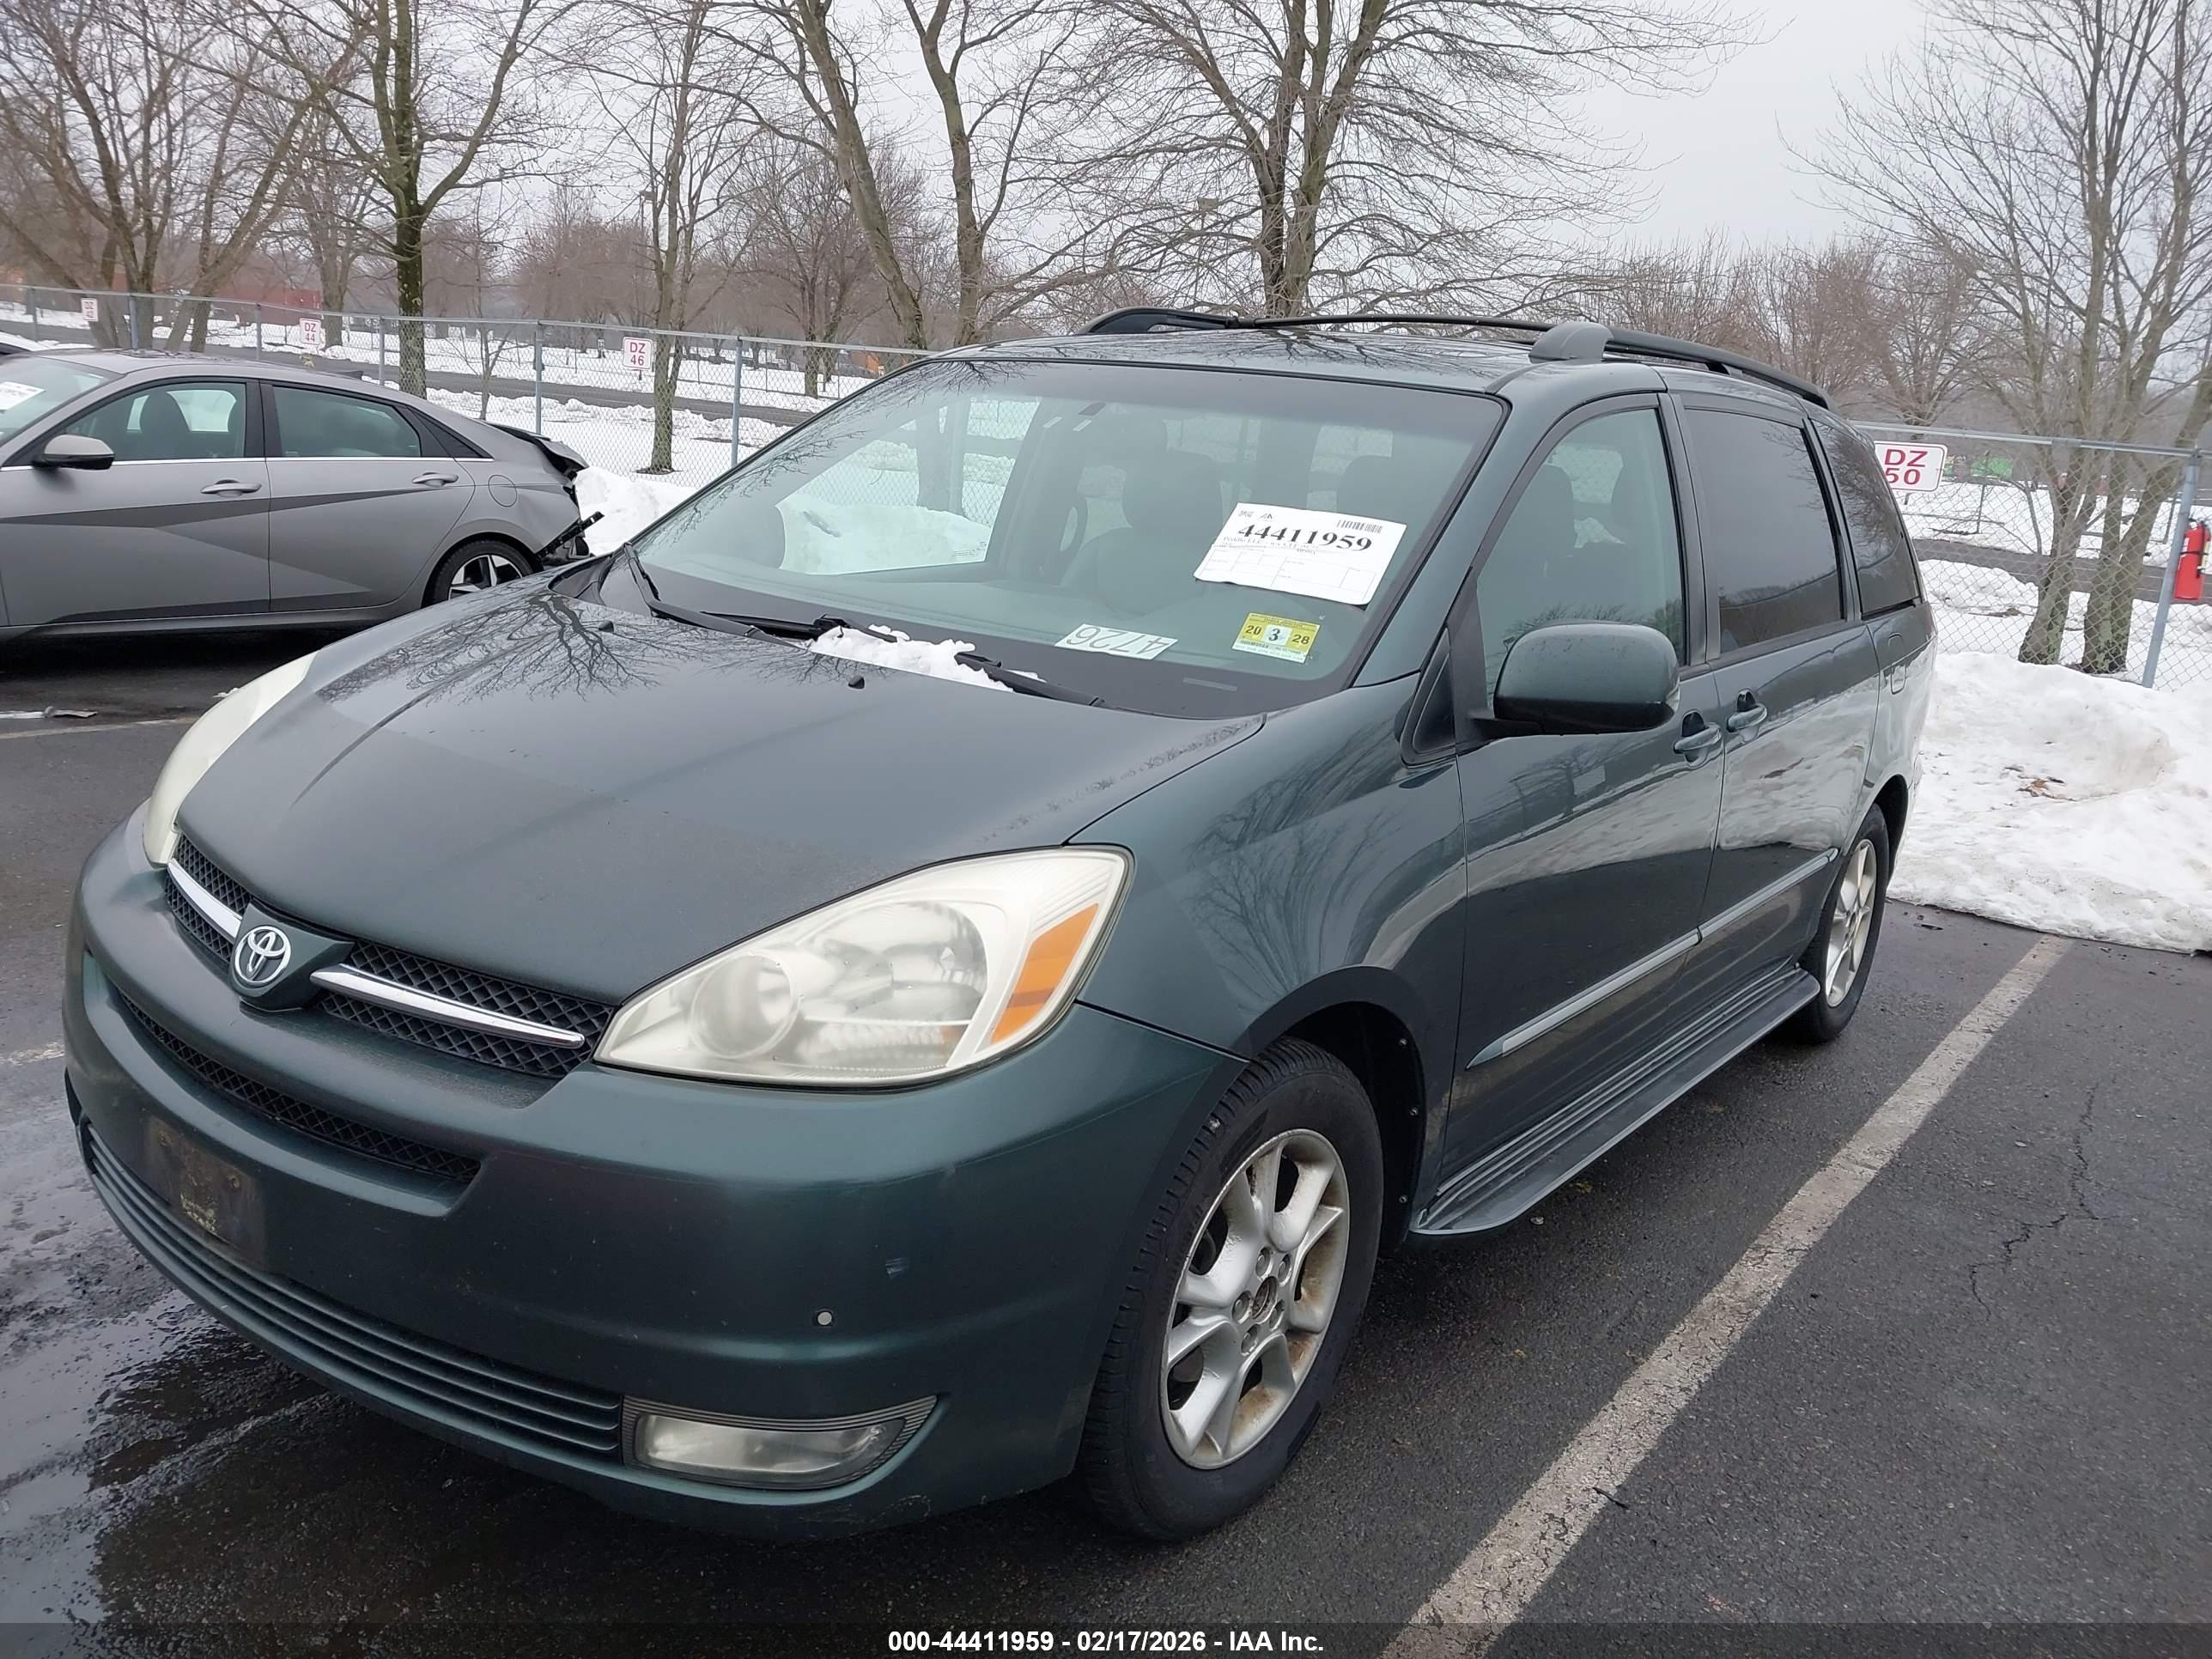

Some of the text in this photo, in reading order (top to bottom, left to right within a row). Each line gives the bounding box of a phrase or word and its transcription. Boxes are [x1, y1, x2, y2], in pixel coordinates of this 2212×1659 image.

[304, 322, 317, 332] DZ
[305, 332, 315, 343] 44
[629, 342, 647, 354] DZ
[630, 354, 645, 366] 46
[1884, 448, 1929, 468] DZ
[1885, 467, 1921, 485] 50
[1237, 523, 1373, 552] 44411959
[1065, 626, 1170, 655] 4726
[1245, 624, 1310, 645] 20 3 28
